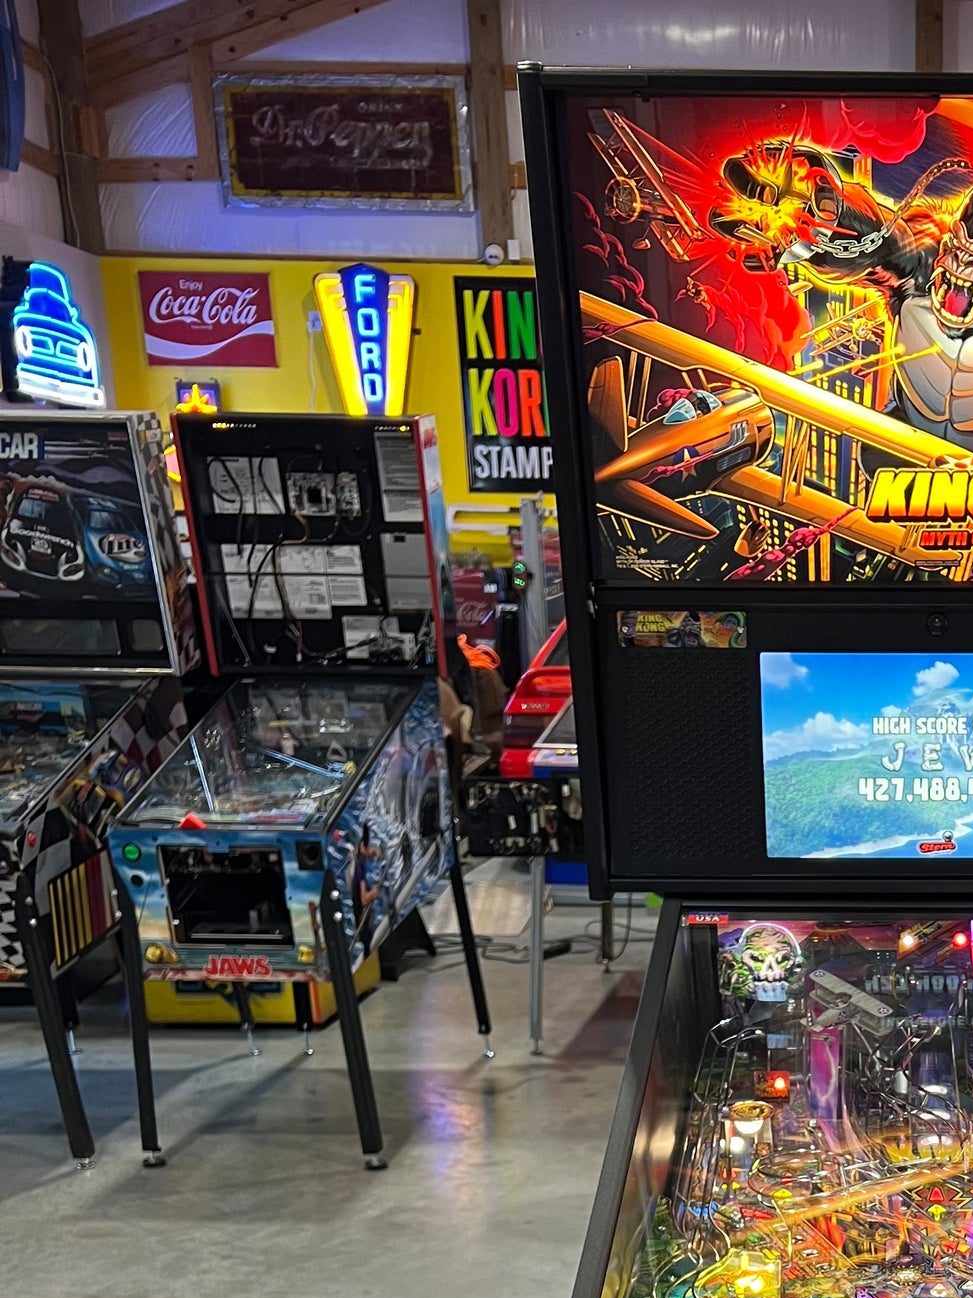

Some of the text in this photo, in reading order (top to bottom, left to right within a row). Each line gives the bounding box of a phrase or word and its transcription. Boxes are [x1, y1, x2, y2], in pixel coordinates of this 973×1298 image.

[304, 104, 432, 168] Pepper
[179, 279, 203, 291] Enjoy
[149, 286, 260, 325] Coca-Cola
[463, 289, 542, 360] KIN
[354, 274, 384, 402] FORD
[468, 367, 551, 438] KOR
[919, 530, 968, 547] MYTH
[636, 622, 667, 633] KONG
[637, 613, 663, 623] KING
[872, 717, 911, 735] HIGH
[916, 716, 967, 735] SCORE
[695, 914, 720, 922] USA
[203, 955, 272, 977] JAWS
